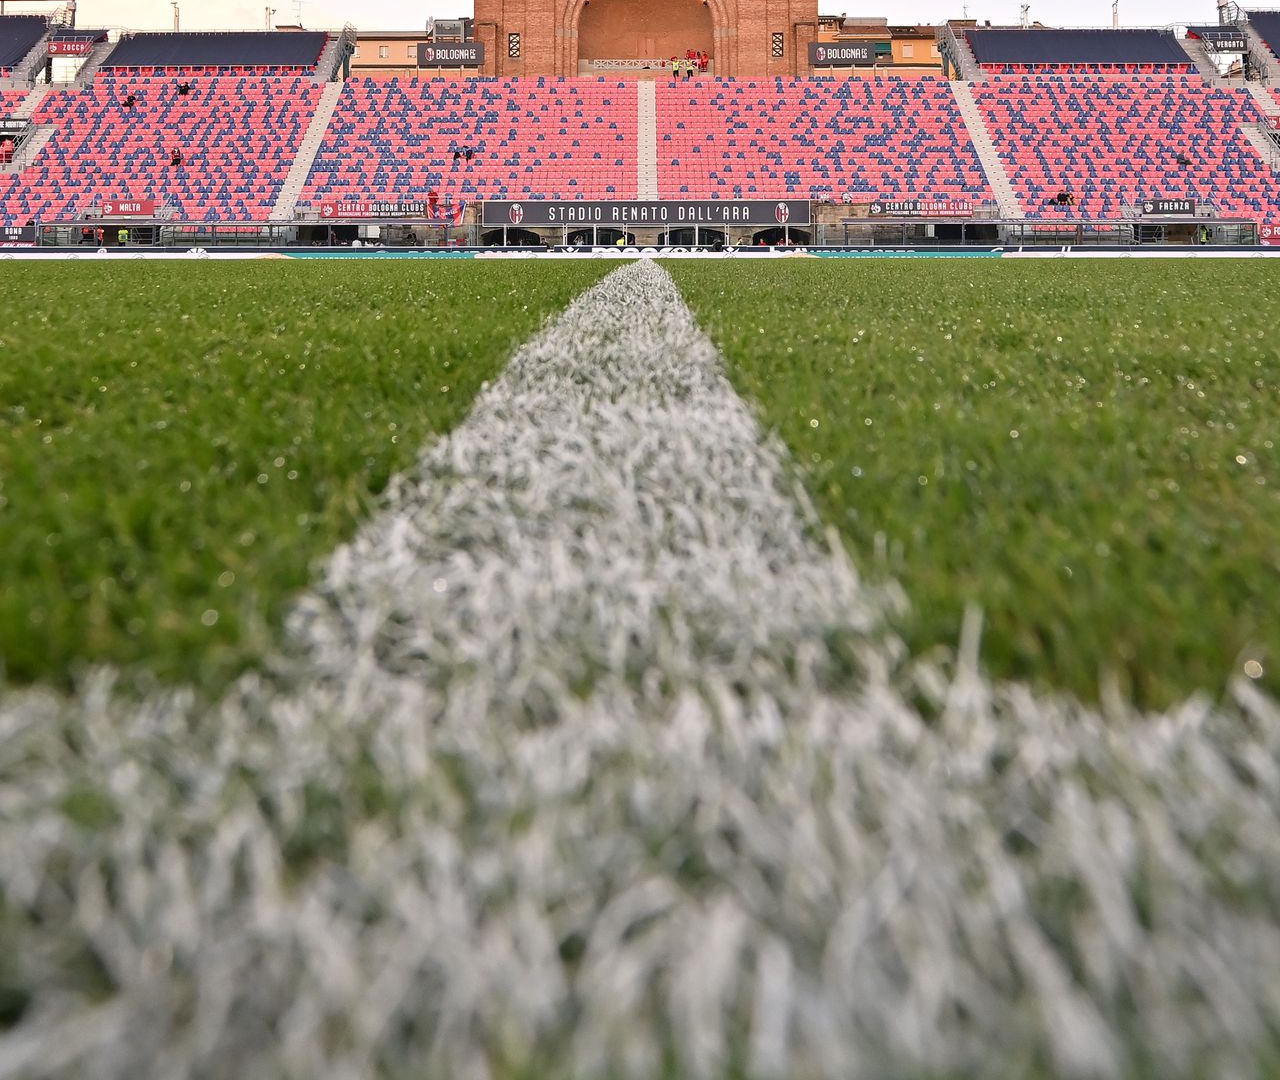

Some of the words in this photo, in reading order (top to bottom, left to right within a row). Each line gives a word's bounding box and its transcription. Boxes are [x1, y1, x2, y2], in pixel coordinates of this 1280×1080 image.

[436, 49, 469, 60] BOLOGNA
[827, 48, 861, 59] BOLOGNA
[119, 204, 140, 212] MALTA
[337, 204, 365, 212] CENTRO
[368, 204, 398, 212] BOLOGNA
[401, 204, 424, 212] CLUBS
[885, 202, 913, 210] CENTRO
[917, 202, 947, 210] BOLOGNA
[950, 202, 973, 210] CLUBS
[1159, 202, 1190, 210] FAENZA
[549, 207, 601, 220] STADIO
[612, 207, 667, 220] RENATO
[678, 206, 750, 220] DALL'ARA
